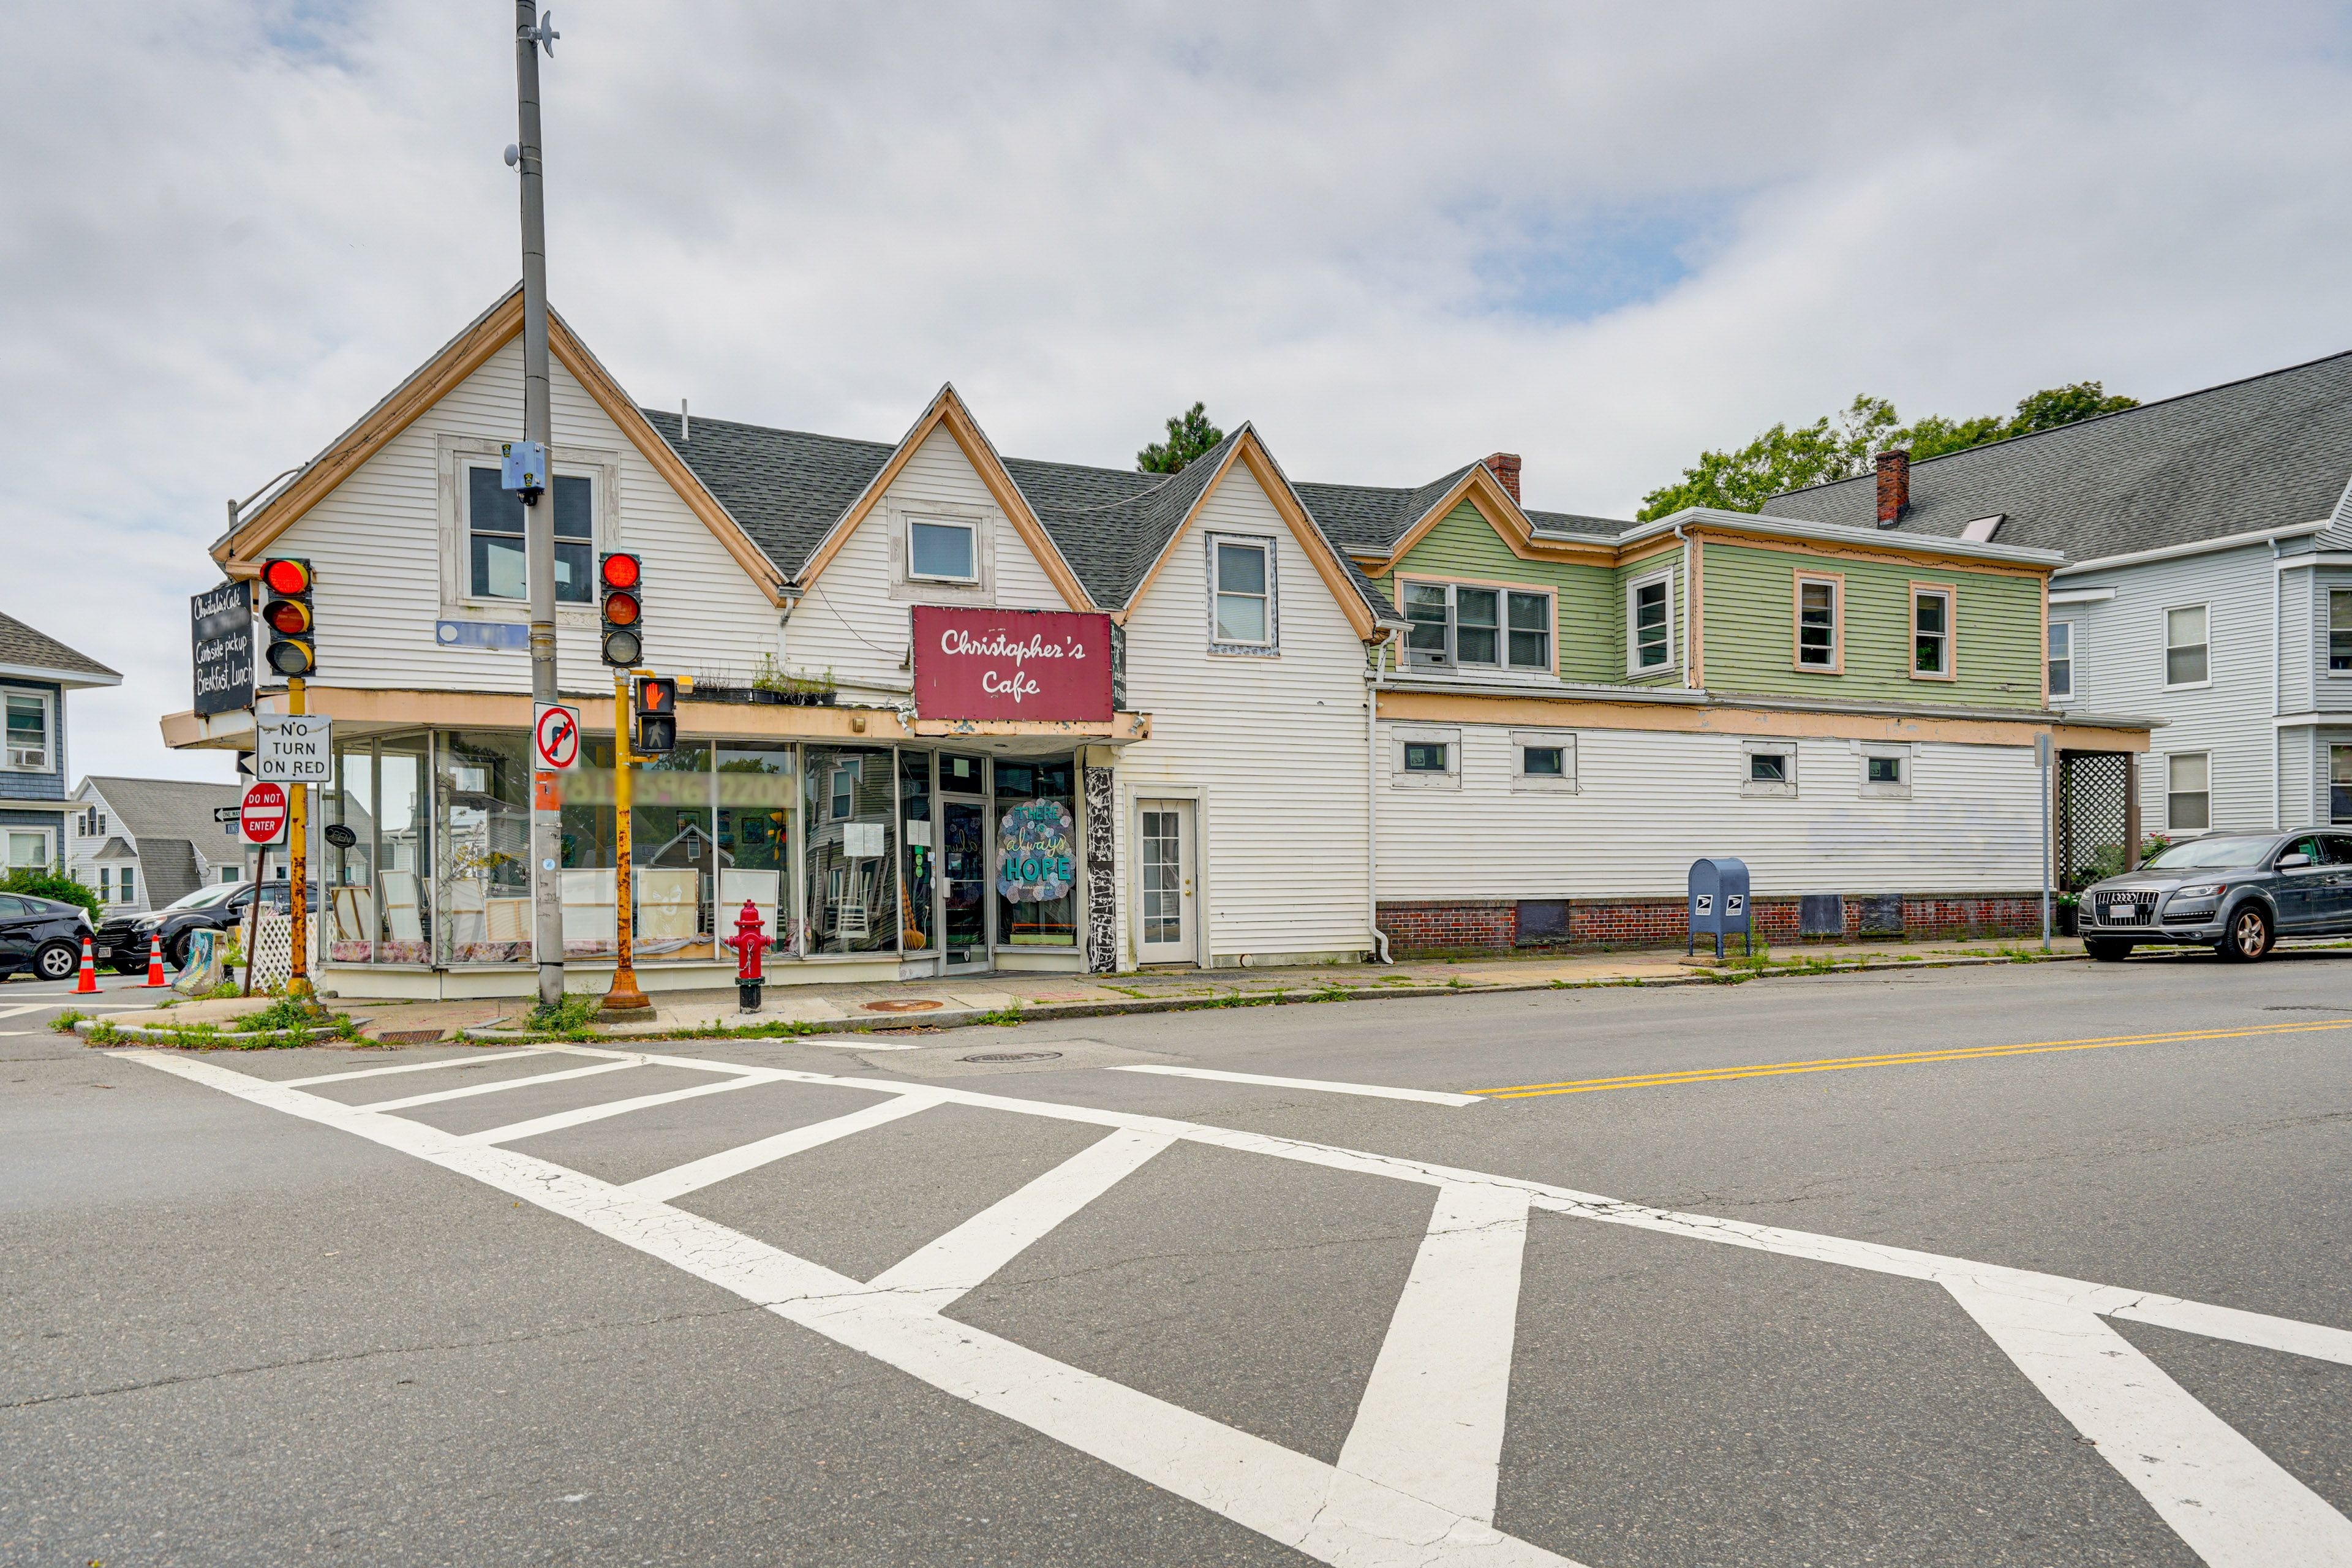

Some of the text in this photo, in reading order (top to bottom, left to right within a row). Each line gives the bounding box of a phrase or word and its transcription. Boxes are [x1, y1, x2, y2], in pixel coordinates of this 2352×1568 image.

[196, 639, 224, 665] Curbside
[941, 630, 1086, 667] Christopher's
[232, 657, 253, 686] Lunch
[982, 671, 1040, 703] Cafe
[281, 724, 307, 736] NO
[273, 742, 315, 755] TURN
[263, 761, 325, 774] ON RED
[248, 793, 281, 804] DO NOT
[1014, 805, 1060, 821] THERE
[227, 824, 238, 834] KING
[249, 821, 275, 831] ENTER
[326, 828, 352, 843] OPEN
[1006, 827, 1066, 858] always
[1005, 858, 1071, 881] HOPE
